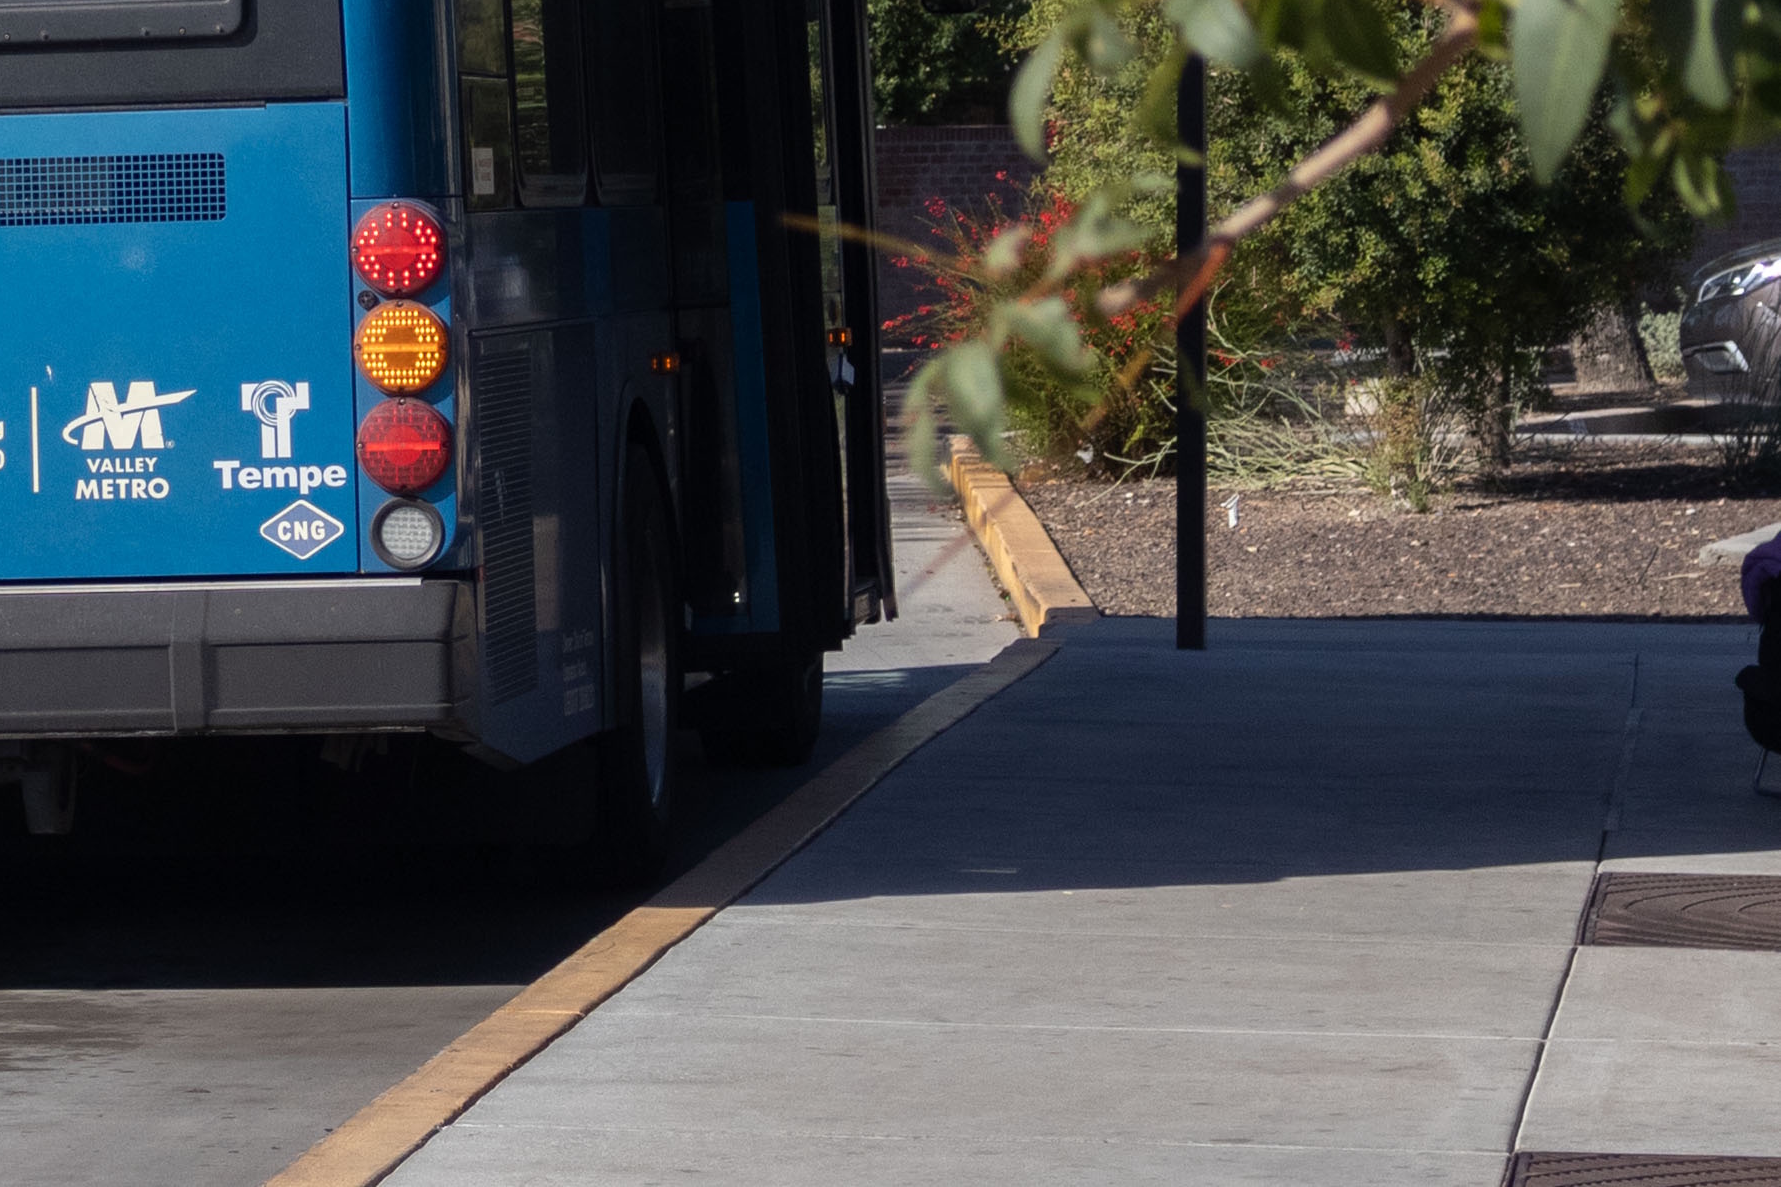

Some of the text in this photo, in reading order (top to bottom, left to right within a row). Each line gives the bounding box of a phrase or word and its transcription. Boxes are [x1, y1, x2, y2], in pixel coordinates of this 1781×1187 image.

[87, 457, 158, 474] VALLEY
[213, 460, 347, 495] Tempe
[75, 478, 170, 500] METRO
[277, 520, 326, 542] CNG
